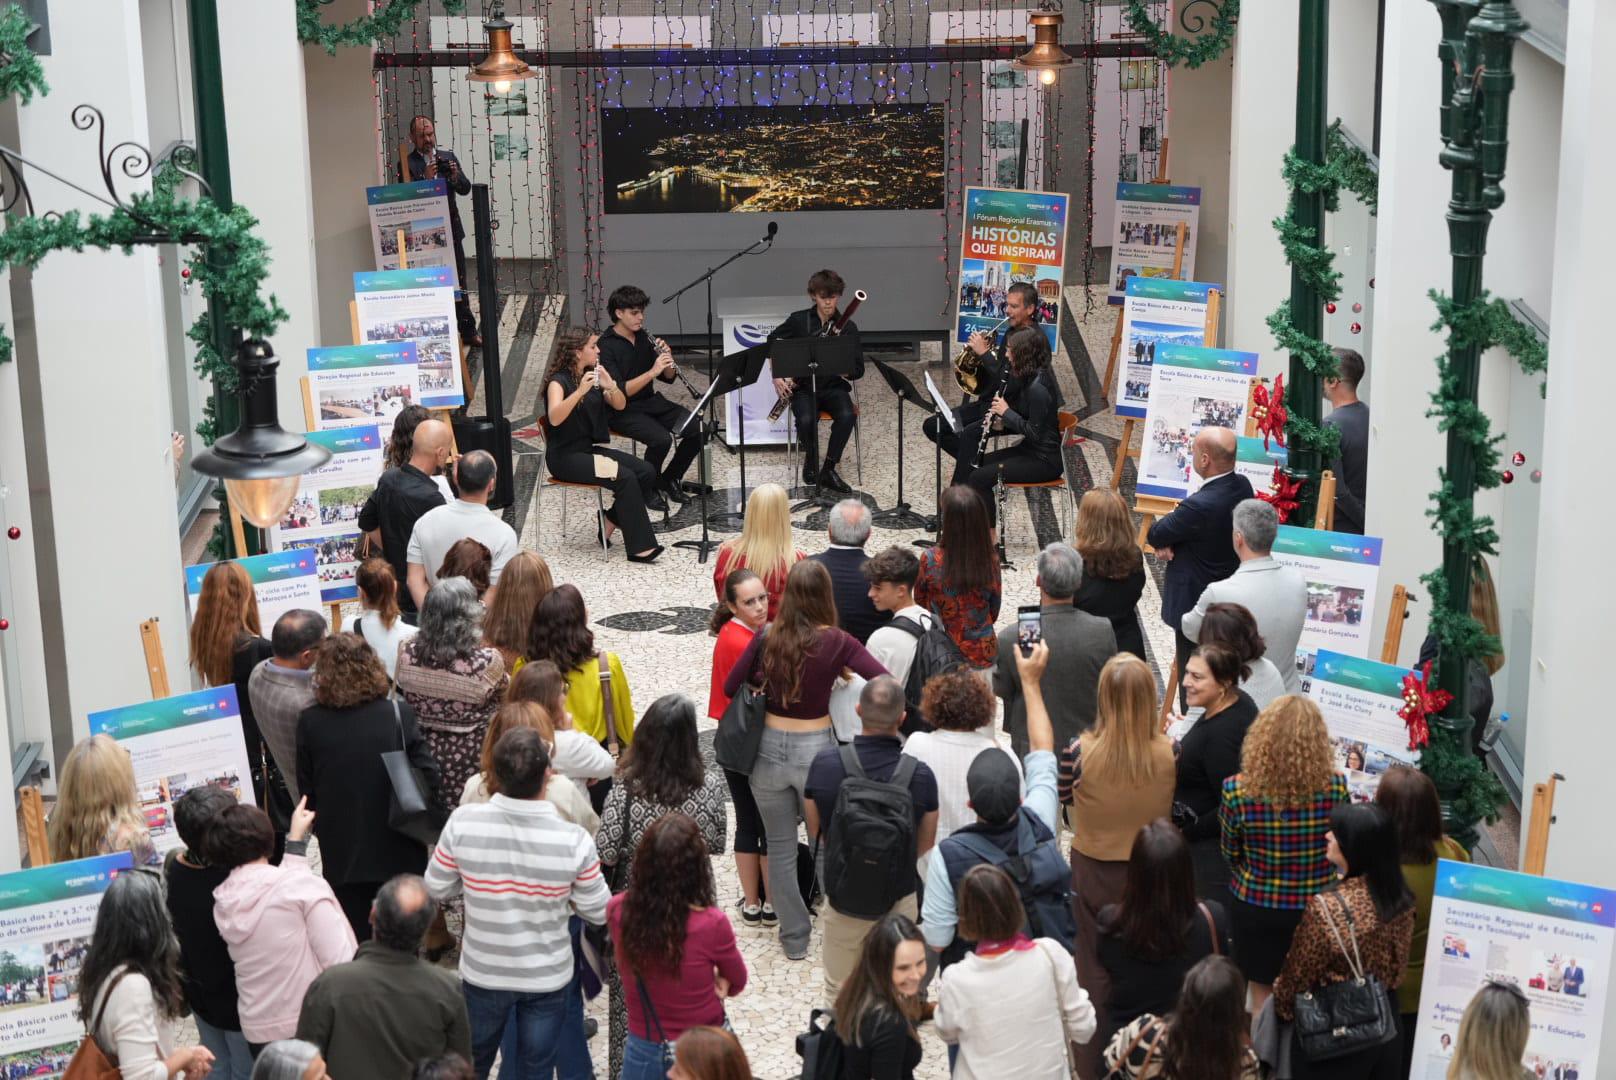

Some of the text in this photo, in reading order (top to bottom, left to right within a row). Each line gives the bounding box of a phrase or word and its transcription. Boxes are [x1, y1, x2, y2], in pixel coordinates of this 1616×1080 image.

[999, 216, 1025, 224] Regional
[1026, 218, 1051, 226] Erasmus
[972, 226, 1056, 247] HISTÓRIAS
[971, 243, 1056, 260] QUE INSPIRAM
[1329, 629, 1359, 638] Gonçalves
[1321, 688, 1342, 699] Escola
[1346, 694, 1374, 706] Superior
[1328, 698, 1341, 707] José
[1354, 706, 1372, 717] Cluny
[1, 917, 27, 927] Básica
[30, 913, 45, 921] dos
[20, 922, 51, 933] Câmara
[67, 916, 91, 925] Lobos
[1496, 916, 1534, 929] Regional
[1537, 923, 1548, 932] de
[1445, 918, 1475, 929] Ciência
[1485, 926, 1530, 940] Tecnologia
[17, 1017, 46, 1027] Básica
[27, 1028, 46, 1036] Cruz
[1548, 1024, 1585, 1039] Educação
